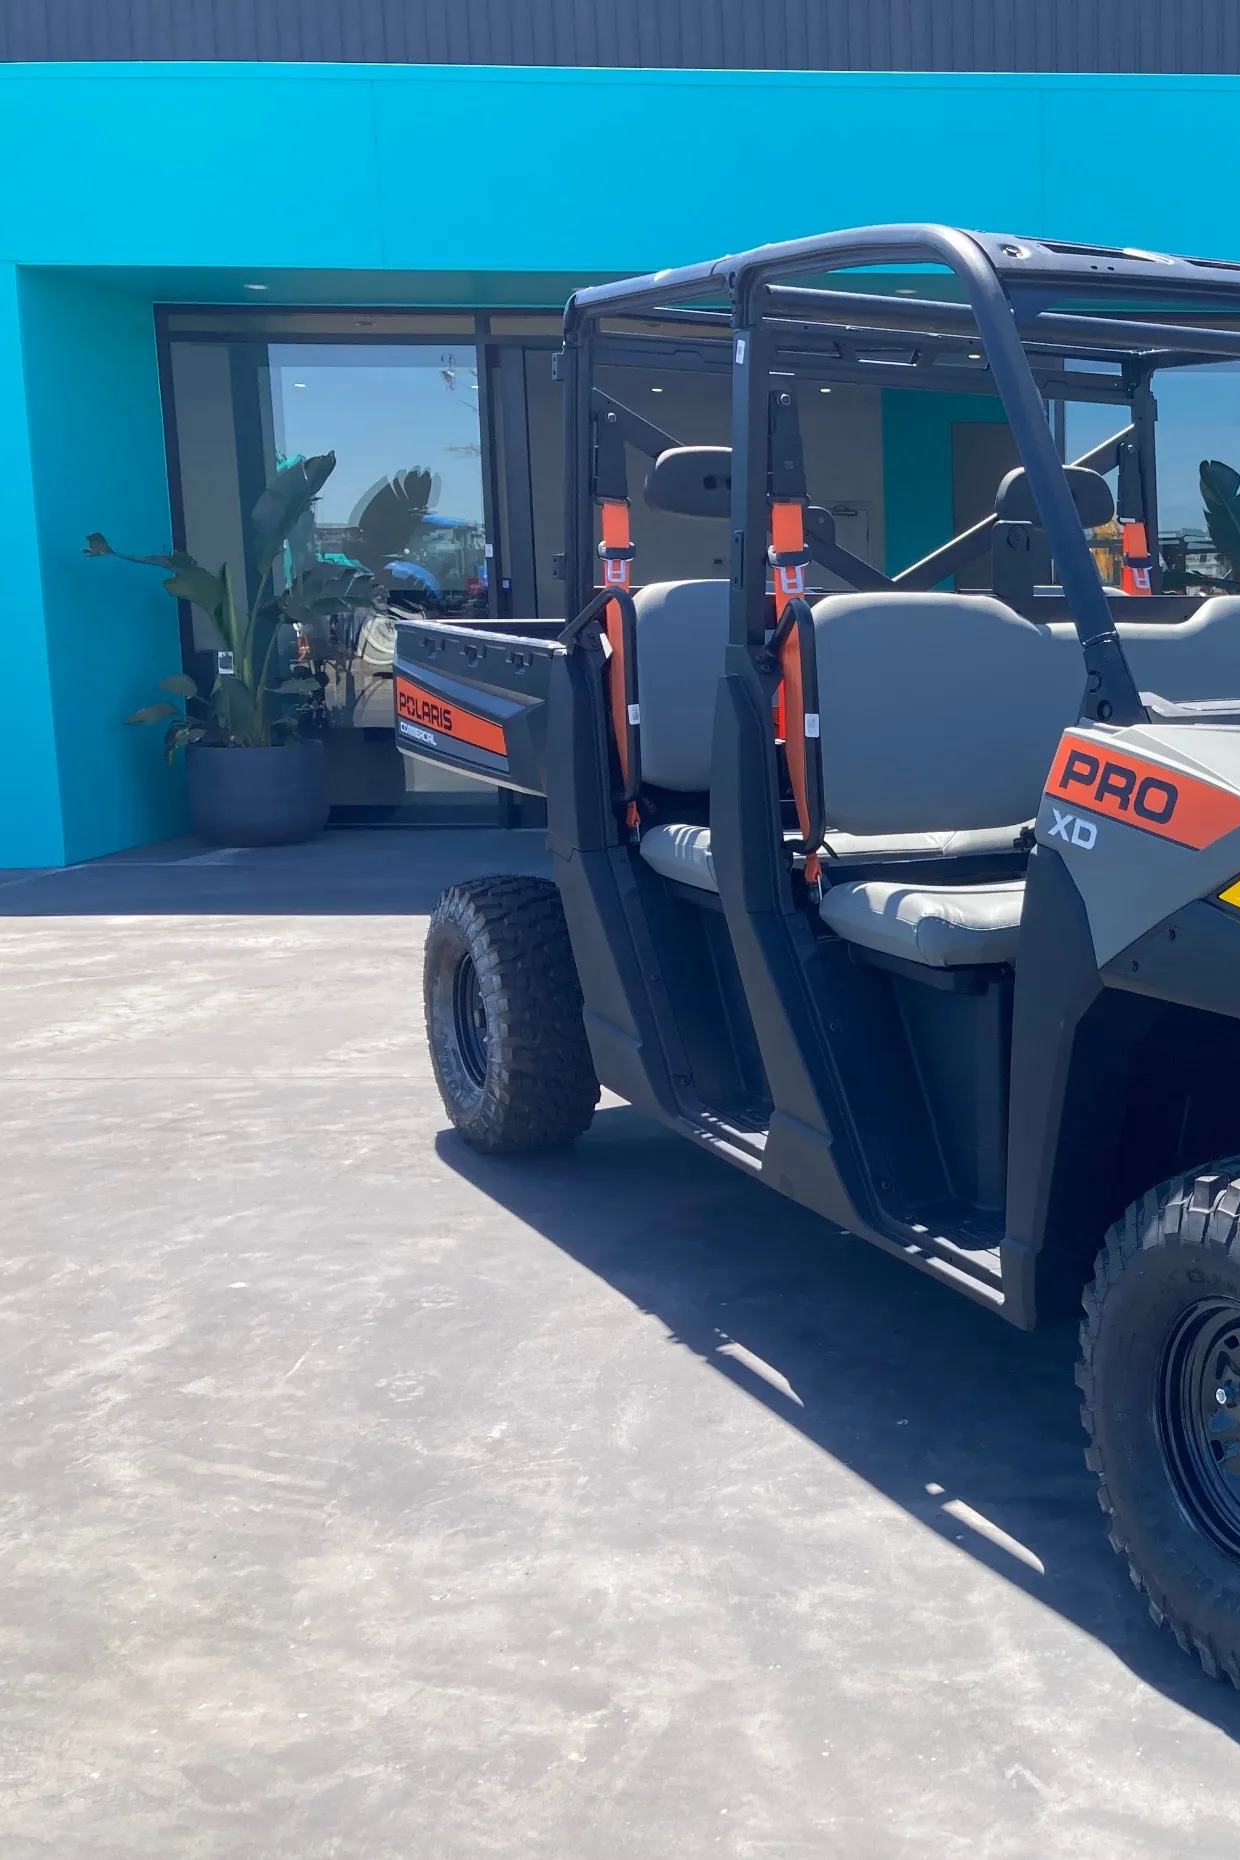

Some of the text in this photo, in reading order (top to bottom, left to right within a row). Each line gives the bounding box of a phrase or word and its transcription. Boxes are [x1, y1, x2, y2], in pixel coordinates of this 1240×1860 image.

[400, 691, 453, 731] POLARIS
[1059, 749, 1178, 824] PRO
[1047, 807, 1098, 850] XD
